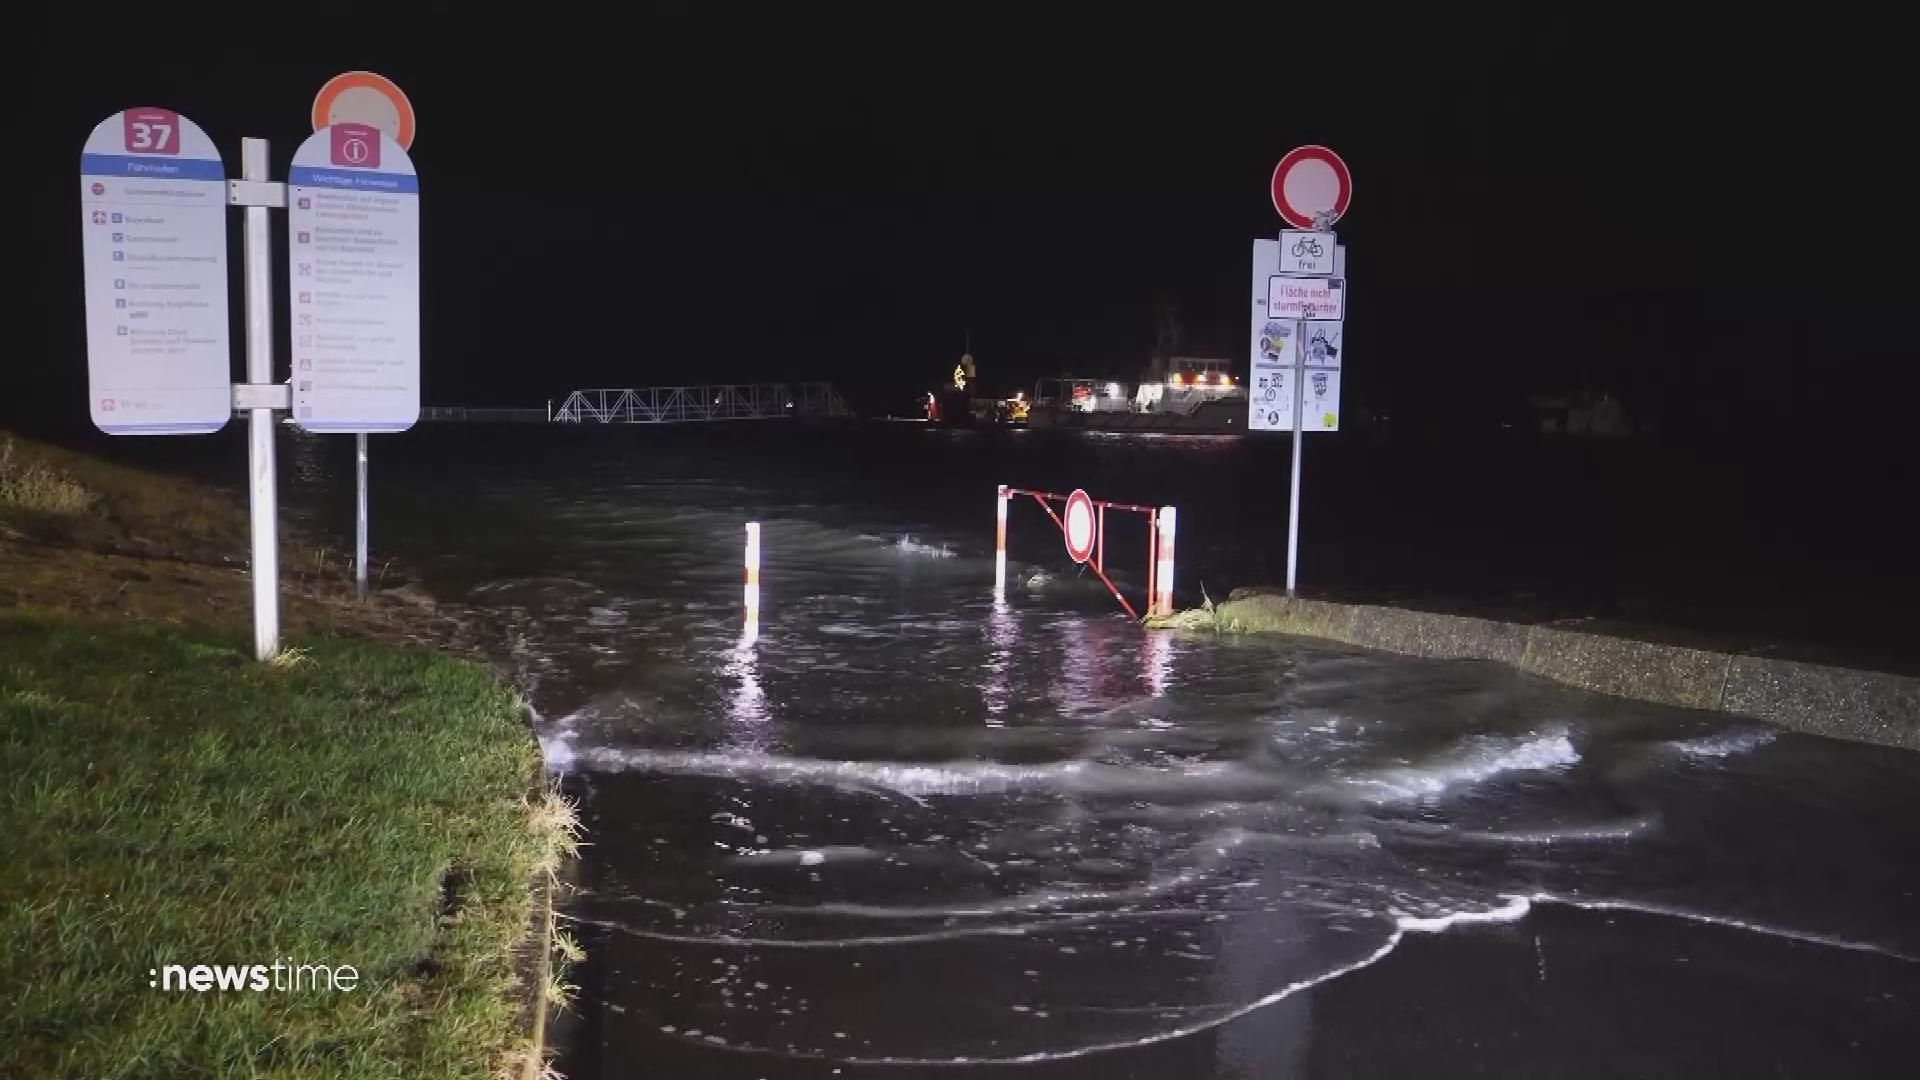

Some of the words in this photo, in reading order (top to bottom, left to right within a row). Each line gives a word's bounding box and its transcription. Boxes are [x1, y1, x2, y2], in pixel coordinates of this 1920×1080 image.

[132, 122, 172, 150] 37
[1298, 260, 1316, 270] frei
[1280, 284, 1309, 298] Fläche
[1310, 287, 1331, 299] nicht
